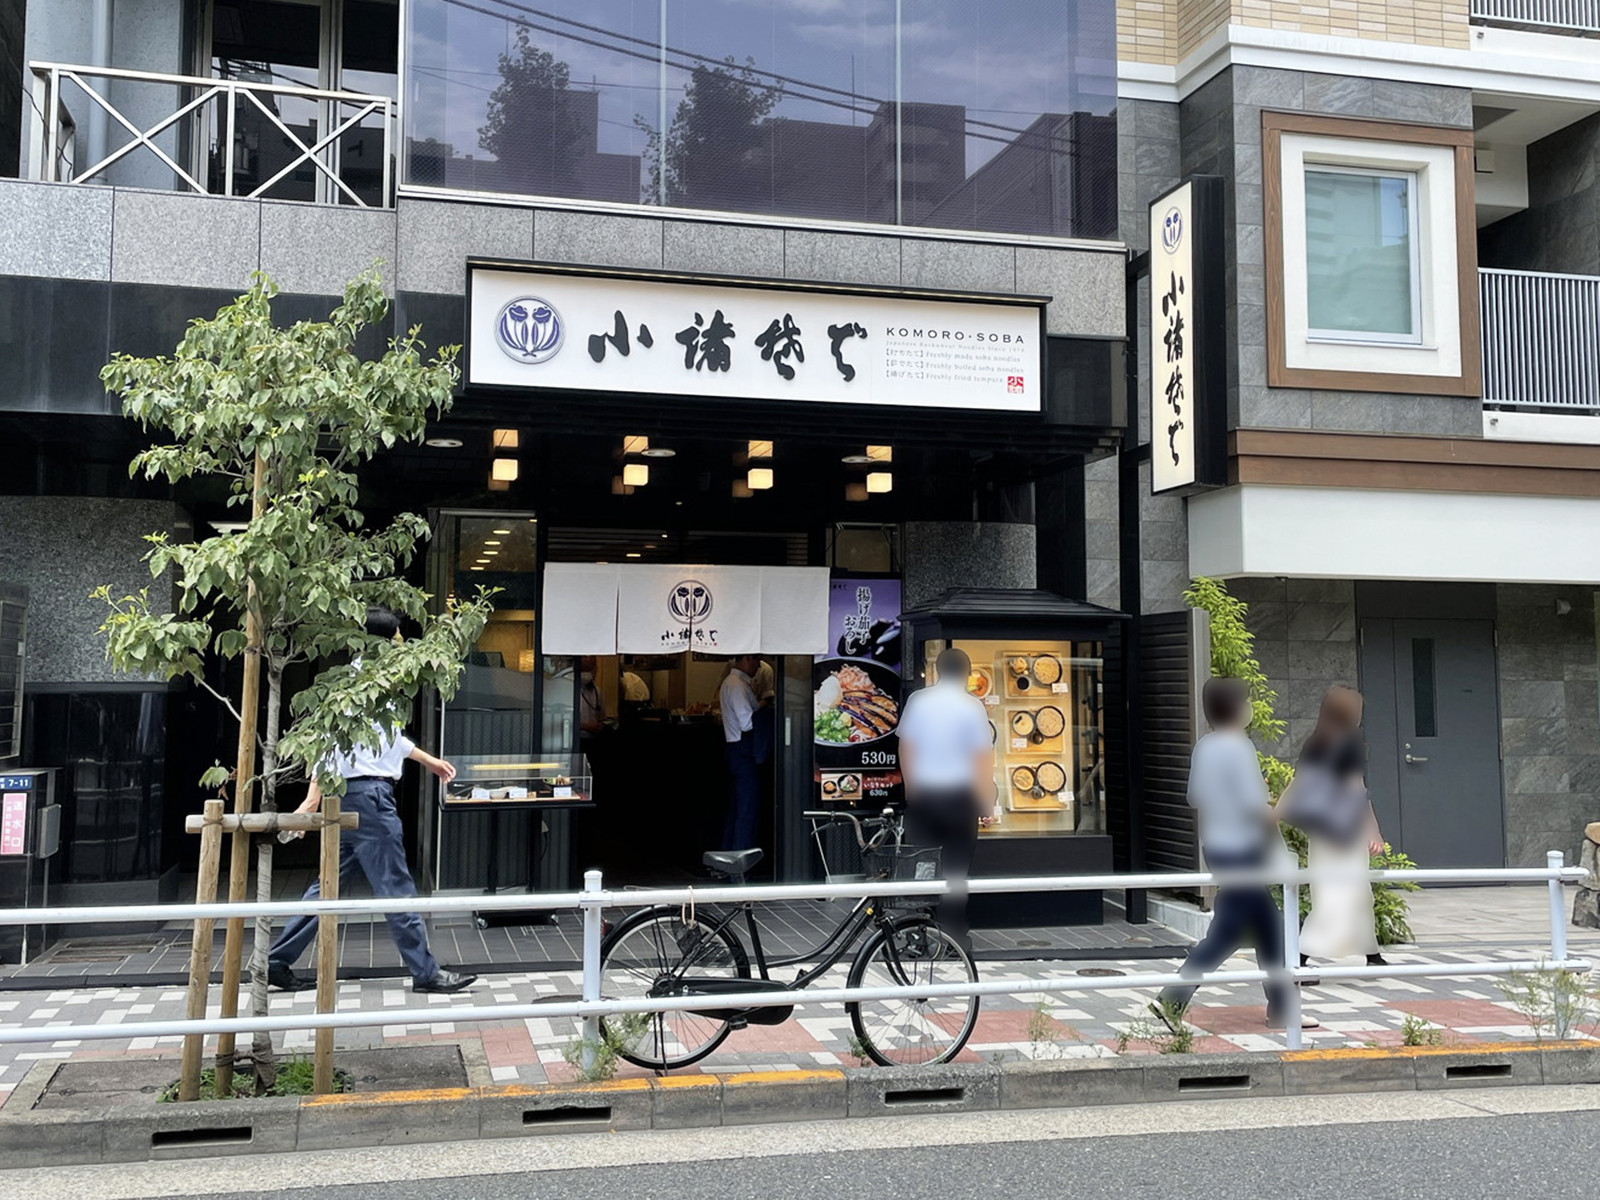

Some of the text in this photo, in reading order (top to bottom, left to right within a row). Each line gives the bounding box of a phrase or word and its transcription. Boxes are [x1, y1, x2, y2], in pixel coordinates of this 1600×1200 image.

[845, 616, 858, 655] おろし
[857, 587, 871, 646] 揚げ茄子
[861, 751, 897, 765] 530円
[8, 778, 29, 787] 7-11
[11, 801, 23, 847] 送水口
